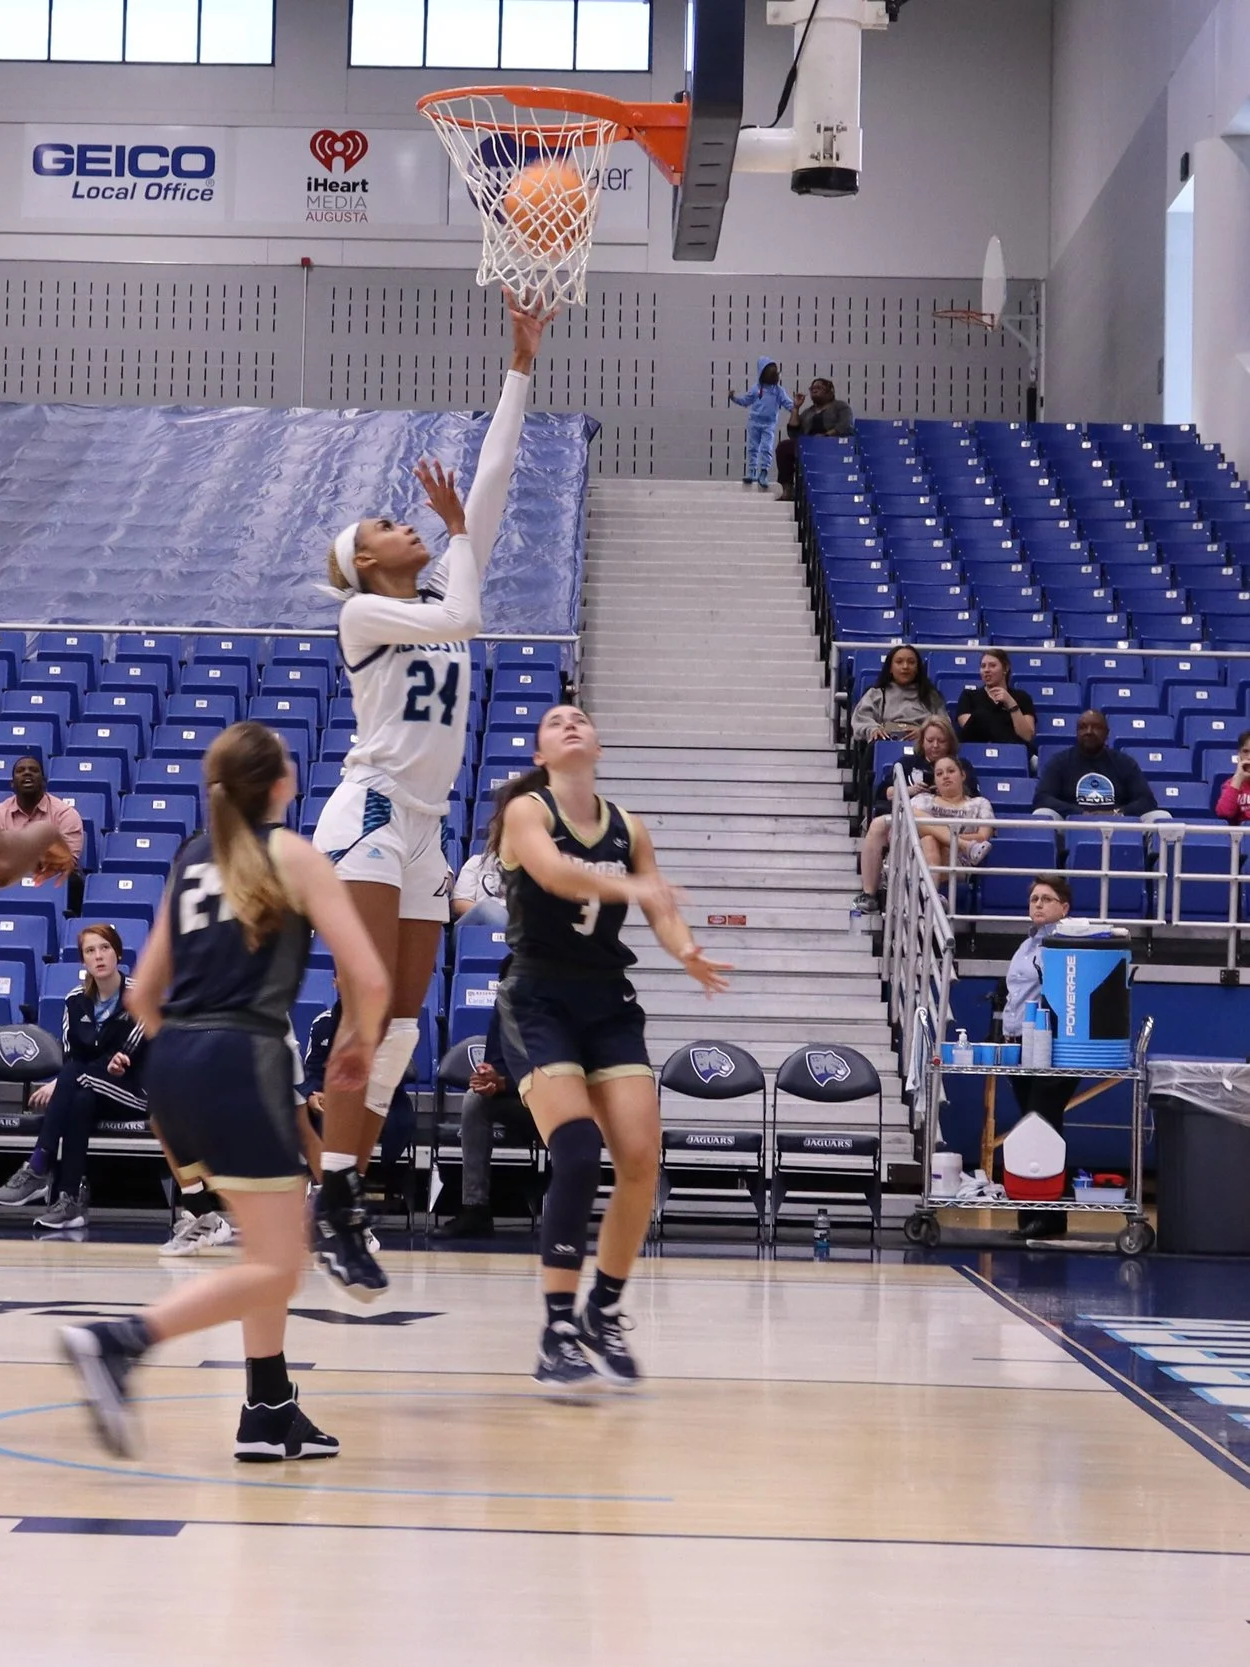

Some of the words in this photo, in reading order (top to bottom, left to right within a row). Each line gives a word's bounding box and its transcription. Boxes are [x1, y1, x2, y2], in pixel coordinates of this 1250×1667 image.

[32, 143, 216, 180] GEICO
[72, 181, 137, 200] Local
[144, 182, 214, 201] Office
[307, 176, 369, 193] iHeart
[307, 195, 367, 209] MEDIA
[305, 211, 369, 223] AUGUSTA
[403, 660, 460, 727] 24
[571, 891, 601, 936] 3
[1066, 955, 1076, 1036] POWERADE
[688, 1135, 735, 1145] JAGUARS
[805, 1138, 851, 1148] JAGUARS
